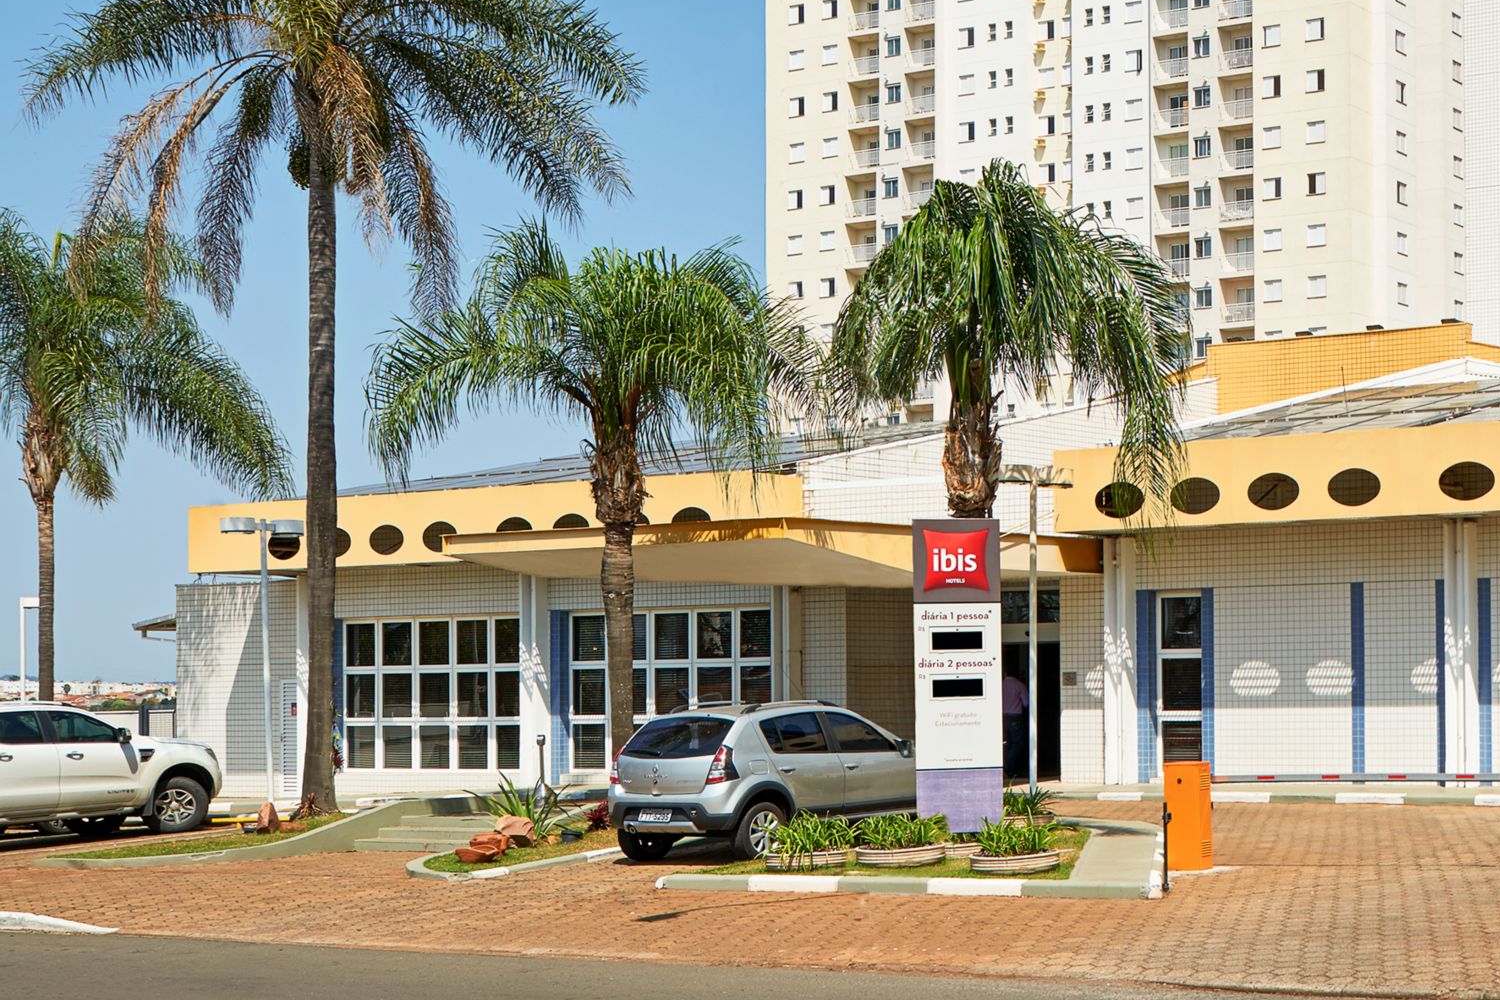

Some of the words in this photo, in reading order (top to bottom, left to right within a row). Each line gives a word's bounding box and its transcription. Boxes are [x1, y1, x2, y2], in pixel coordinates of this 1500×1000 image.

[932, 548, 977, 572] ibis
[921, 610, 948, 620] diária
[950, 611, 954, 620] 1
[918, 657, 945, 668] diária
[947, 659, 953, 668] 2
